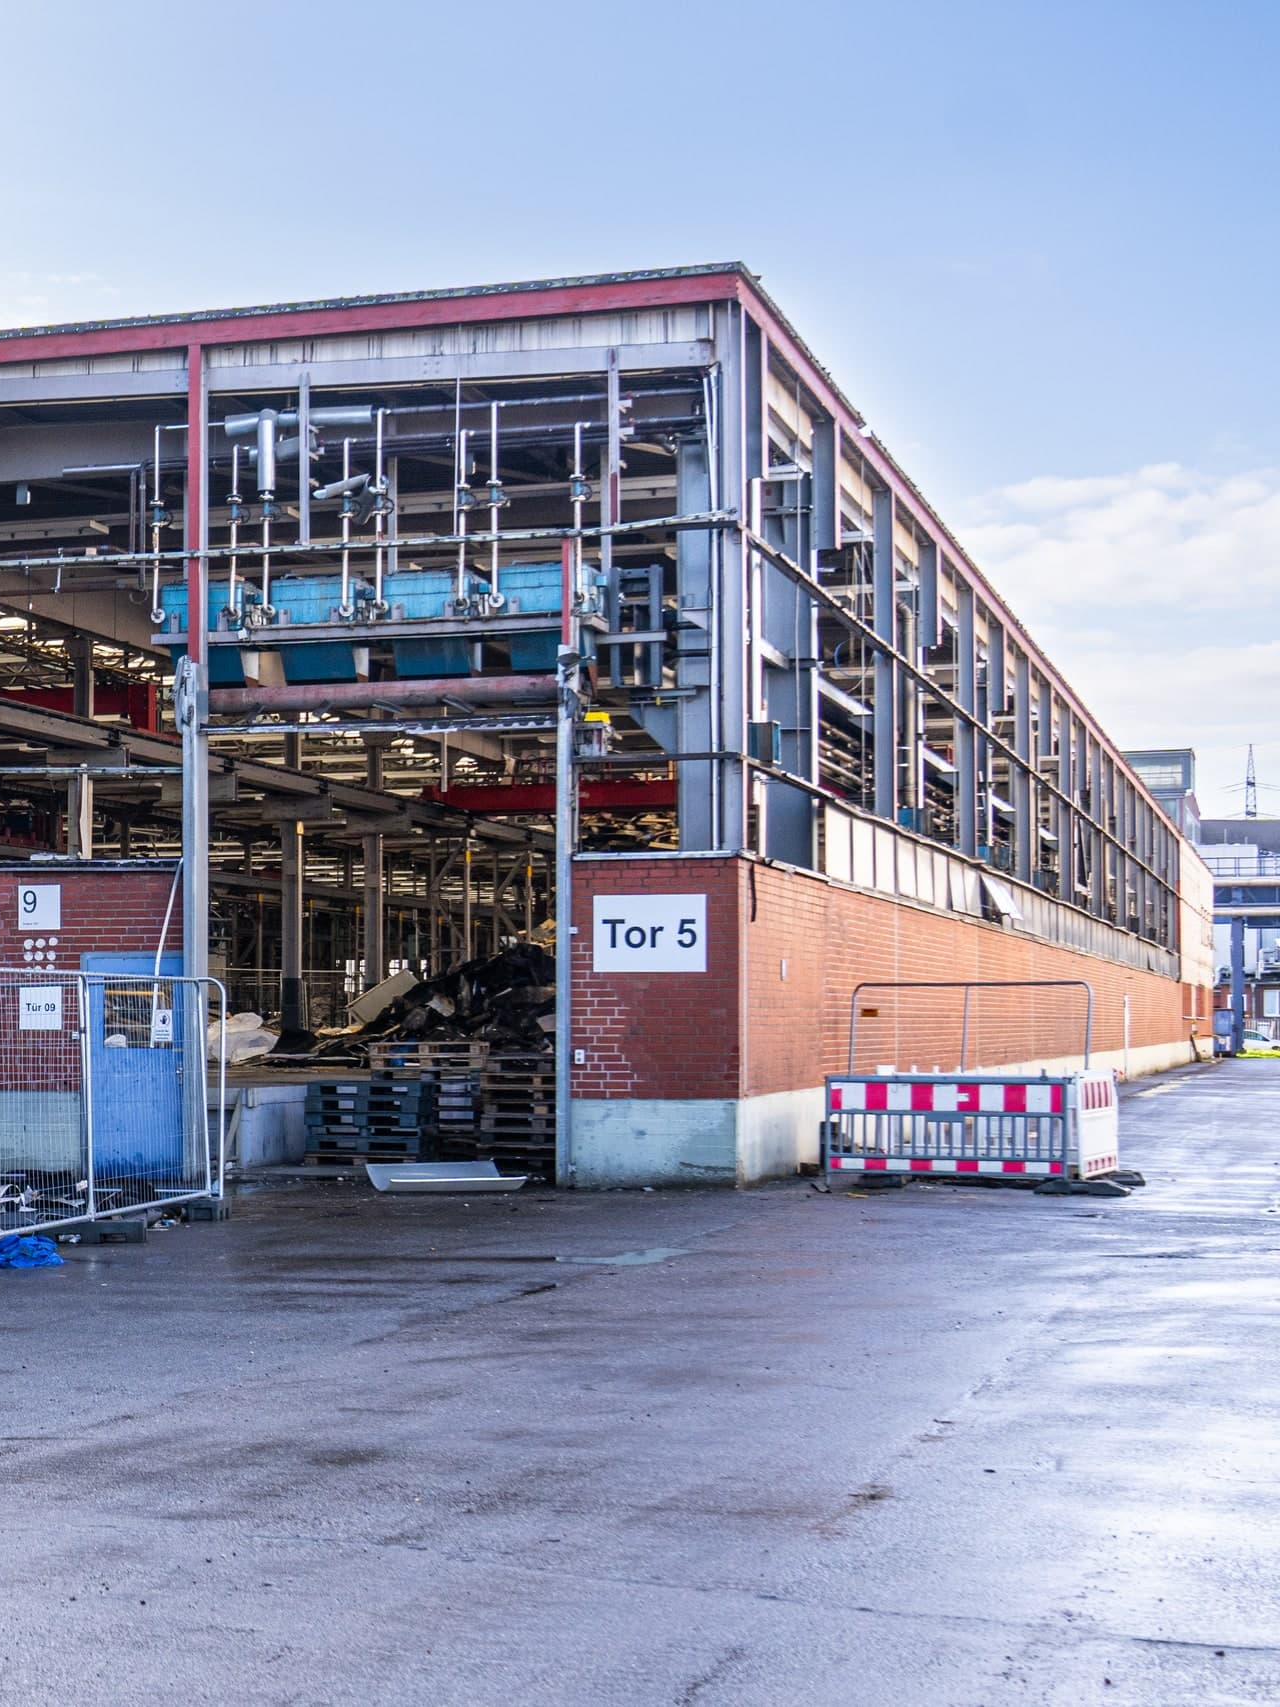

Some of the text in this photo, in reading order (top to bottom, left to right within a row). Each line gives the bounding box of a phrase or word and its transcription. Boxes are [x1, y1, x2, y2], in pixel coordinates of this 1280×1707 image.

[23, 890, 37, 914] 9
[601, 918, 697, 949] Tor 5
[25, 1002, 56, 1012] Tür 09
